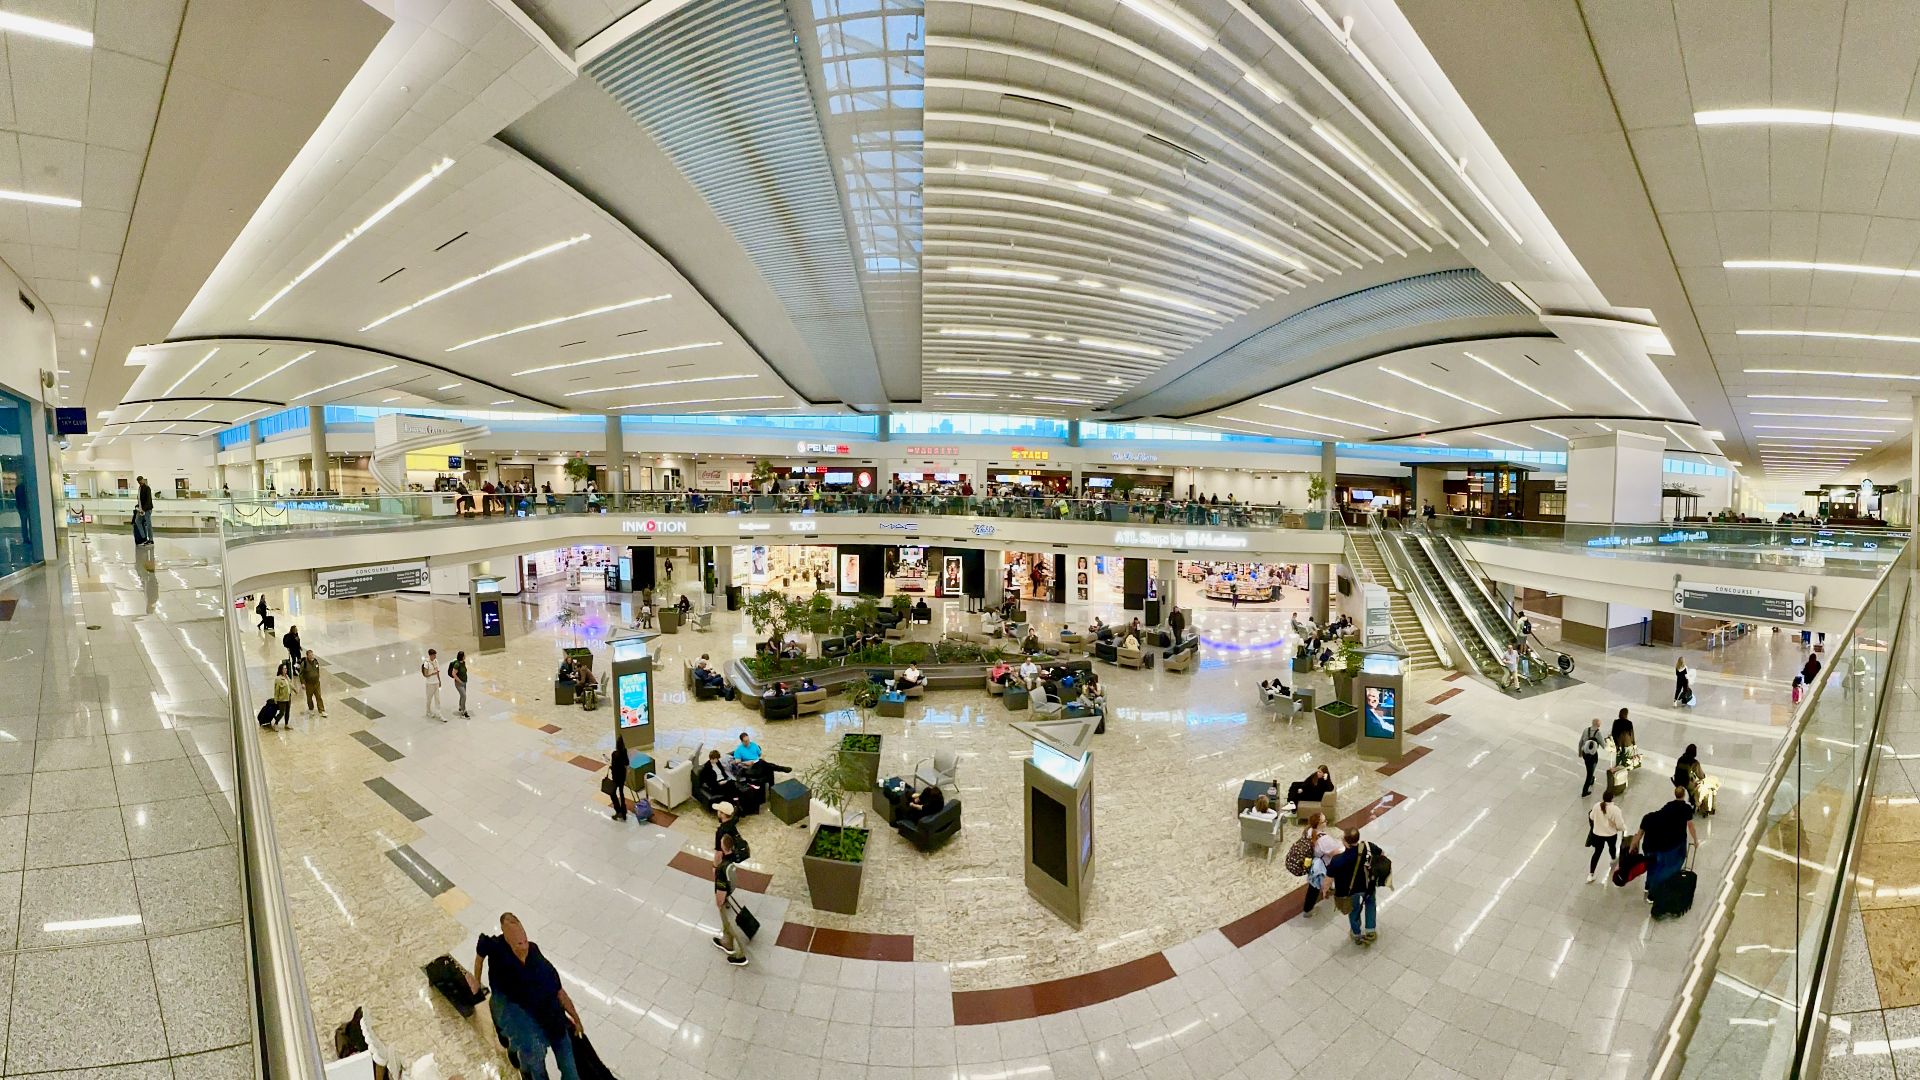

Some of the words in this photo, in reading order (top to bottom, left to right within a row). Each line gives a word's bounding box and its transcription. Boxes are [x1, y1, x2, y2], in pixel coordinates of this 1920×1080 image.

[1022, 450, 1048, 460] TACO
[622, 520, 686, 532] INMOTION
[1715, 586, 1752, 595] CONCOURSE
